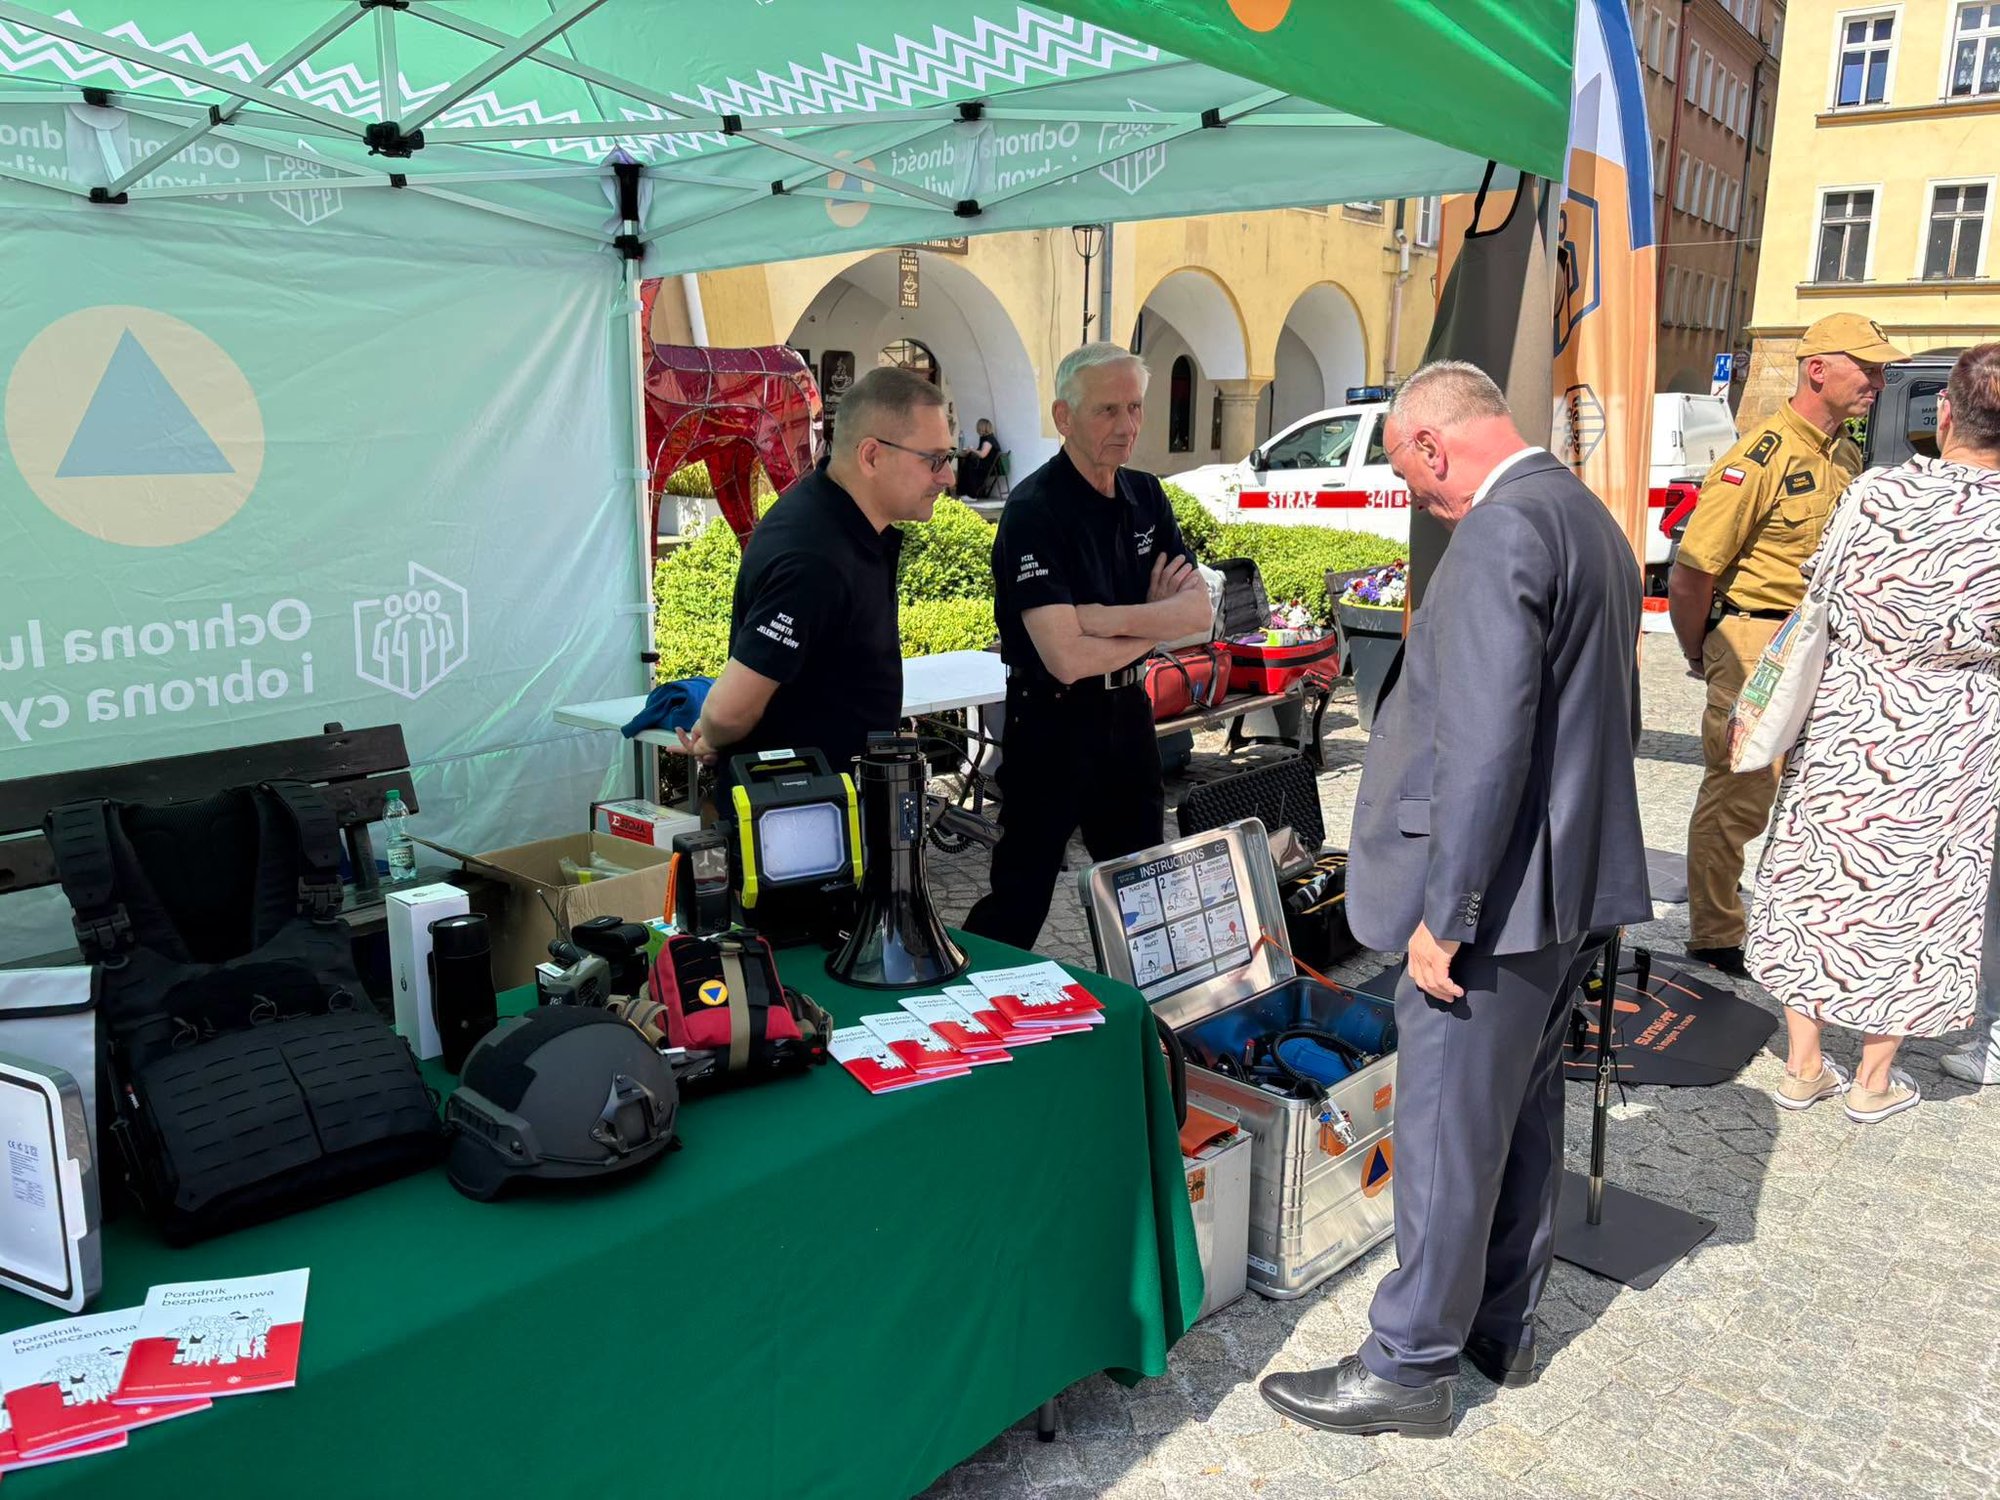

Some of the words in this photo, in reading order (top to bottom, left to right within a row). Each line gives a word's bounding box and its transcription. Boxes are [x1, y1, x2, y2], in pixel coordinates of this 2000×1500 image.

[1139, 848, 1205, 879] INSTRUCTIONS
[1196, 864, 1203, 877] 3
[1159, 877, 1166, 889] 2
[1119, 890, 1126, 902] 1
[1207, 912, 1214, 925] 6
[1169, 926, 1177, 939] 5
[1132, 940, 1139, 953] 4
[161, 1290, 275, 1307] bezpieczeństwa
[164, 1287, 227, 1299] Poradnik
[12, 1325, 83, 1347] Poradnik
[14, 1323, 138, 1355] bezpieczeństwa
